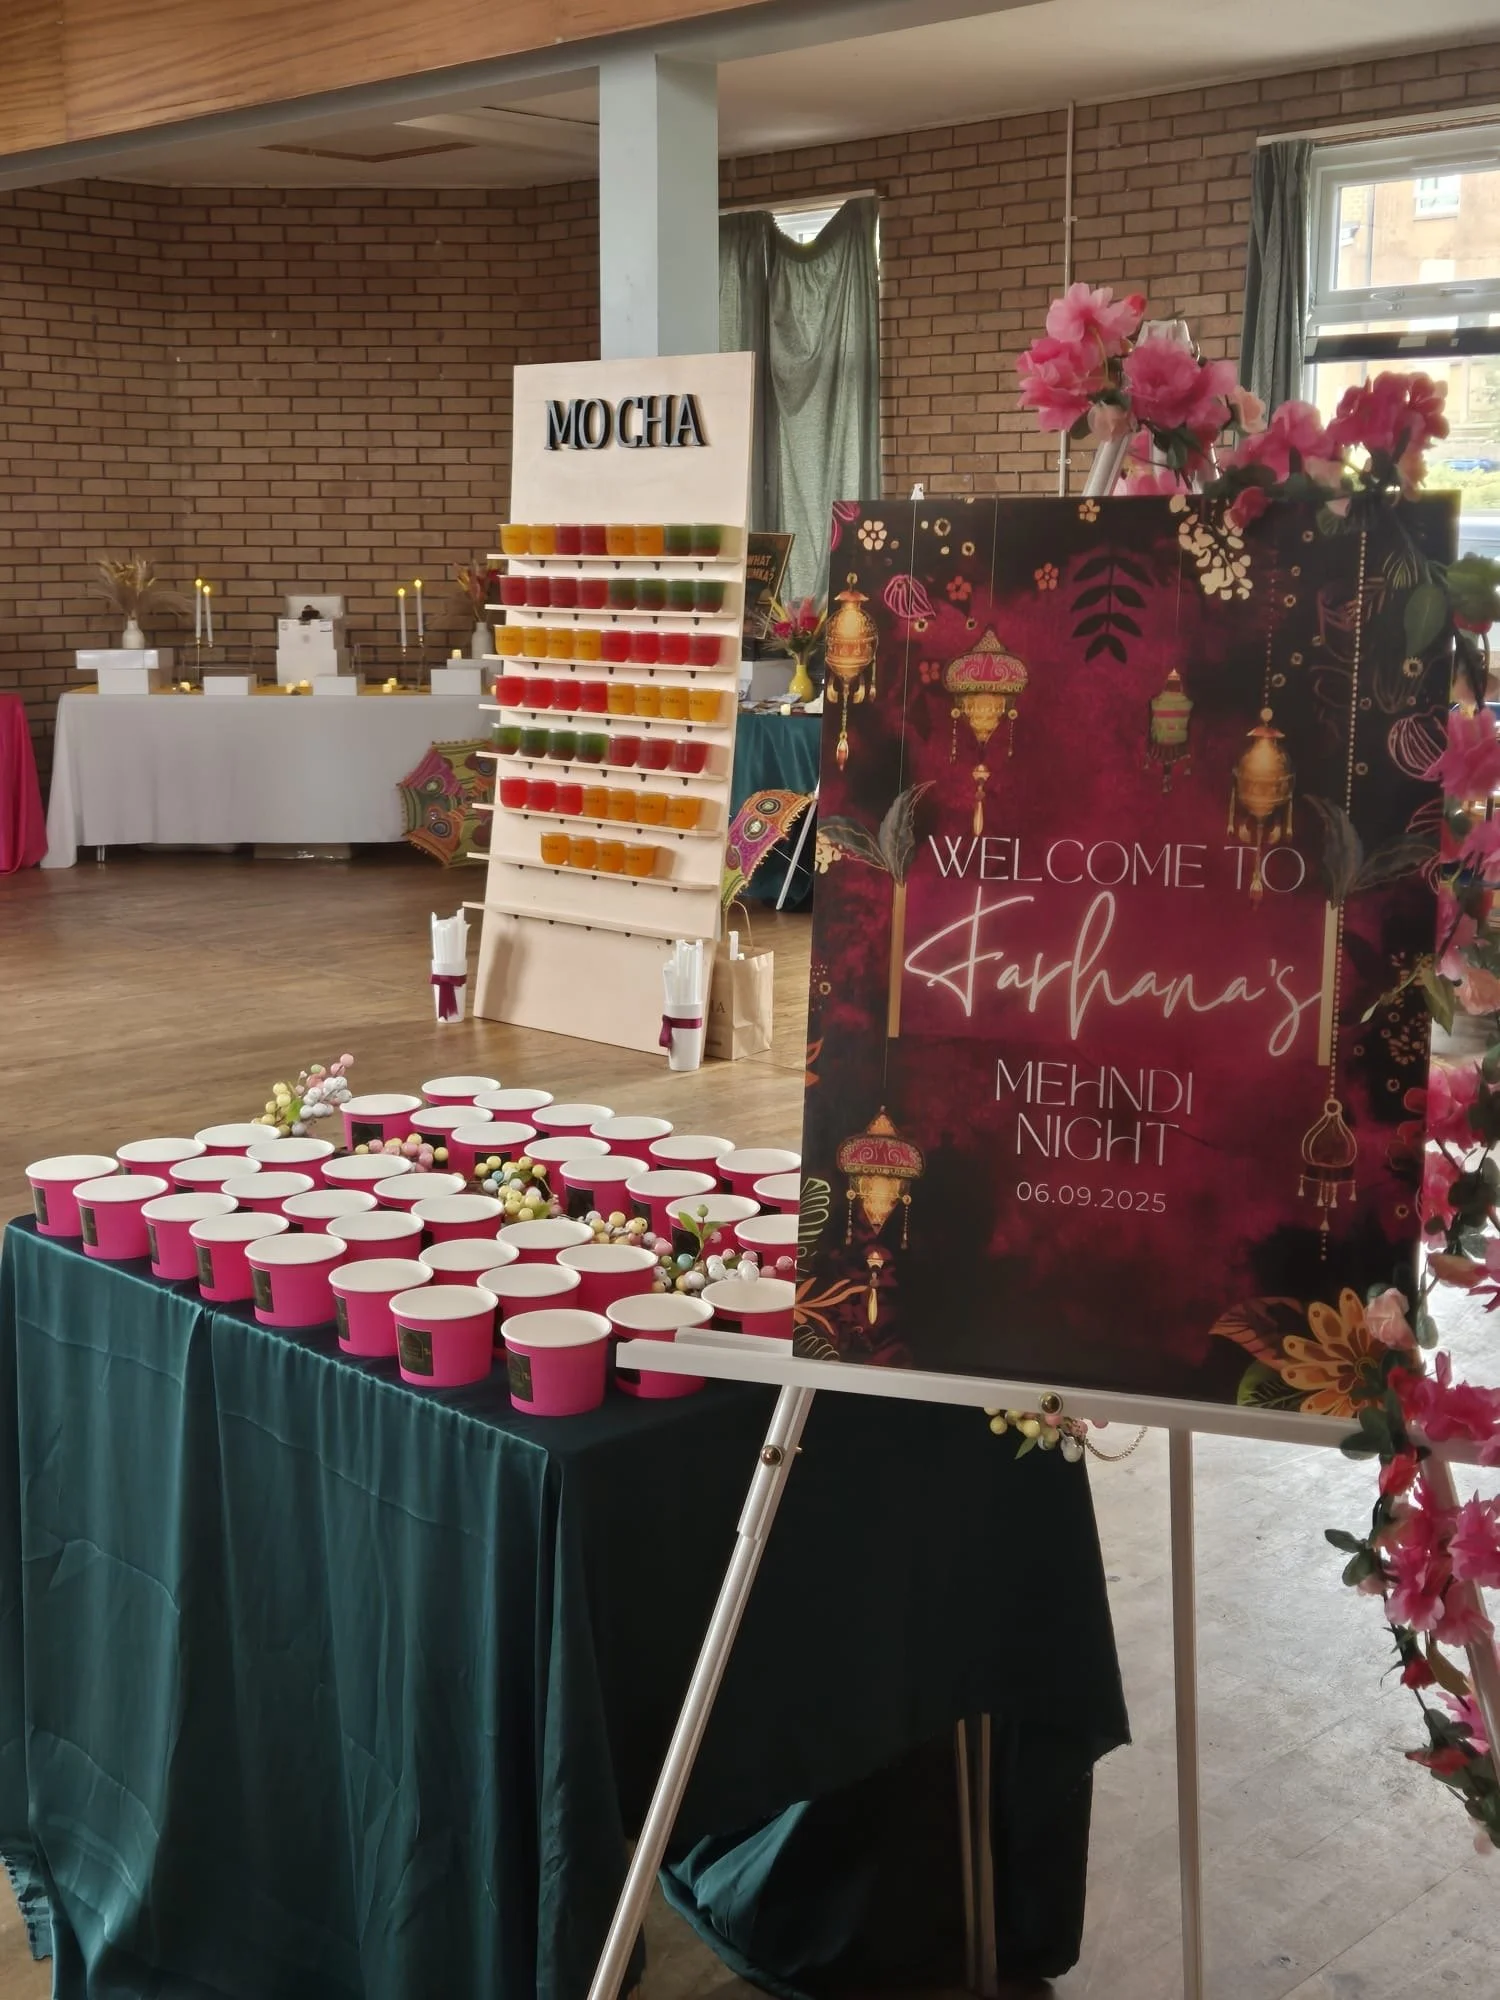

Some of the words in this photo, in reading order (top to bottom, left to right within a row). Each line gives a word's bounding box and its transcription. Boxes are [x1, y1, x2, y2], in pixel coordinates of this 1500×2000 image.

[544, 393, 710, 451] MOCHA
[928, 834, 1207, 888] WELCOME
[1223, 846, 1306, 892] TO
[904, 886, 1322, 1057] Farhana's
[996, 1058, 1193, 1115] MEHNDI
[1016, 1112, 1180, 1166] NIGHT
[1016, 1181, 1166, 1213] 06.09.2025
